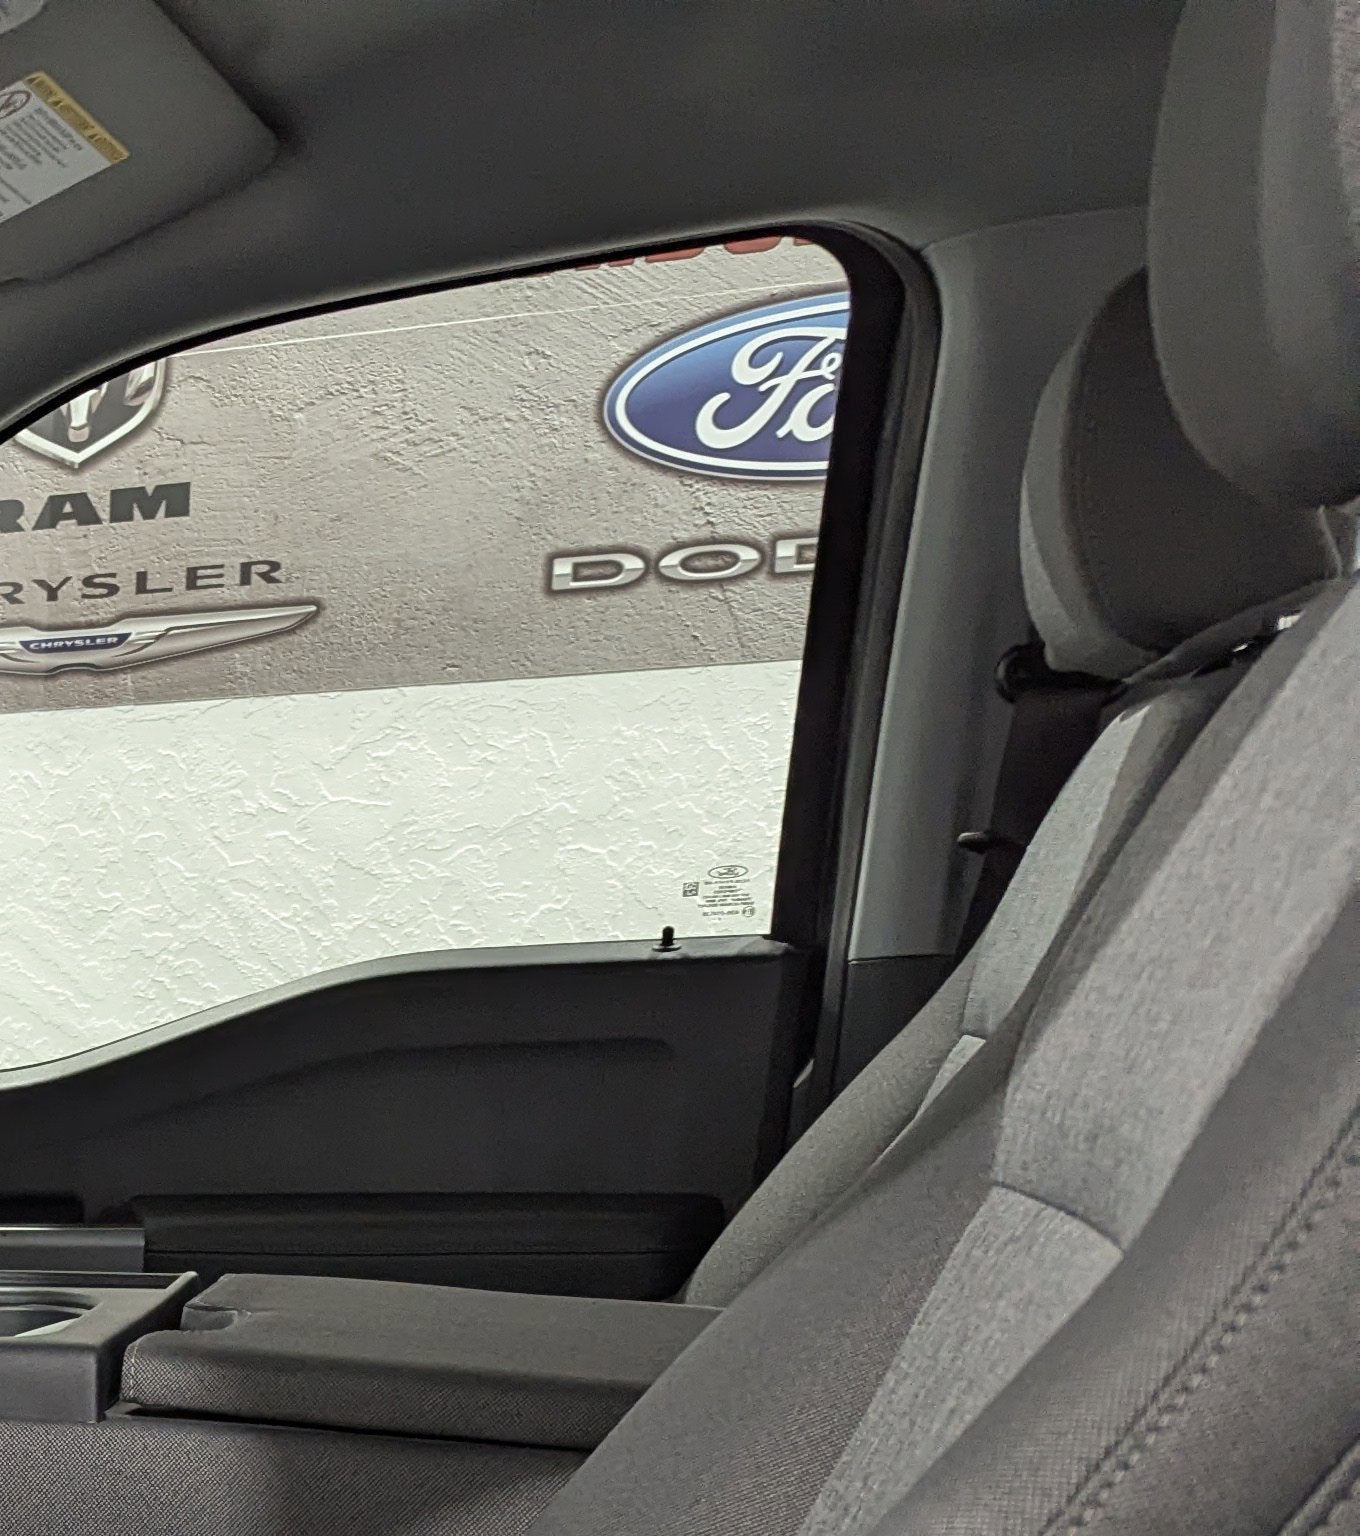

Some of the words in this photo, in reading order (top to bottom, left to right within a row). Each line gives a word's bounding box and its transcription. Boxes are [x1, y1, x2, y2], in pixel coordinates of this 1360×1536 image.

[695, 327, 846, 449] Fo
[551, 537, 817, 591] DOD
[29, 637, 120, 651] CHRYSLER
